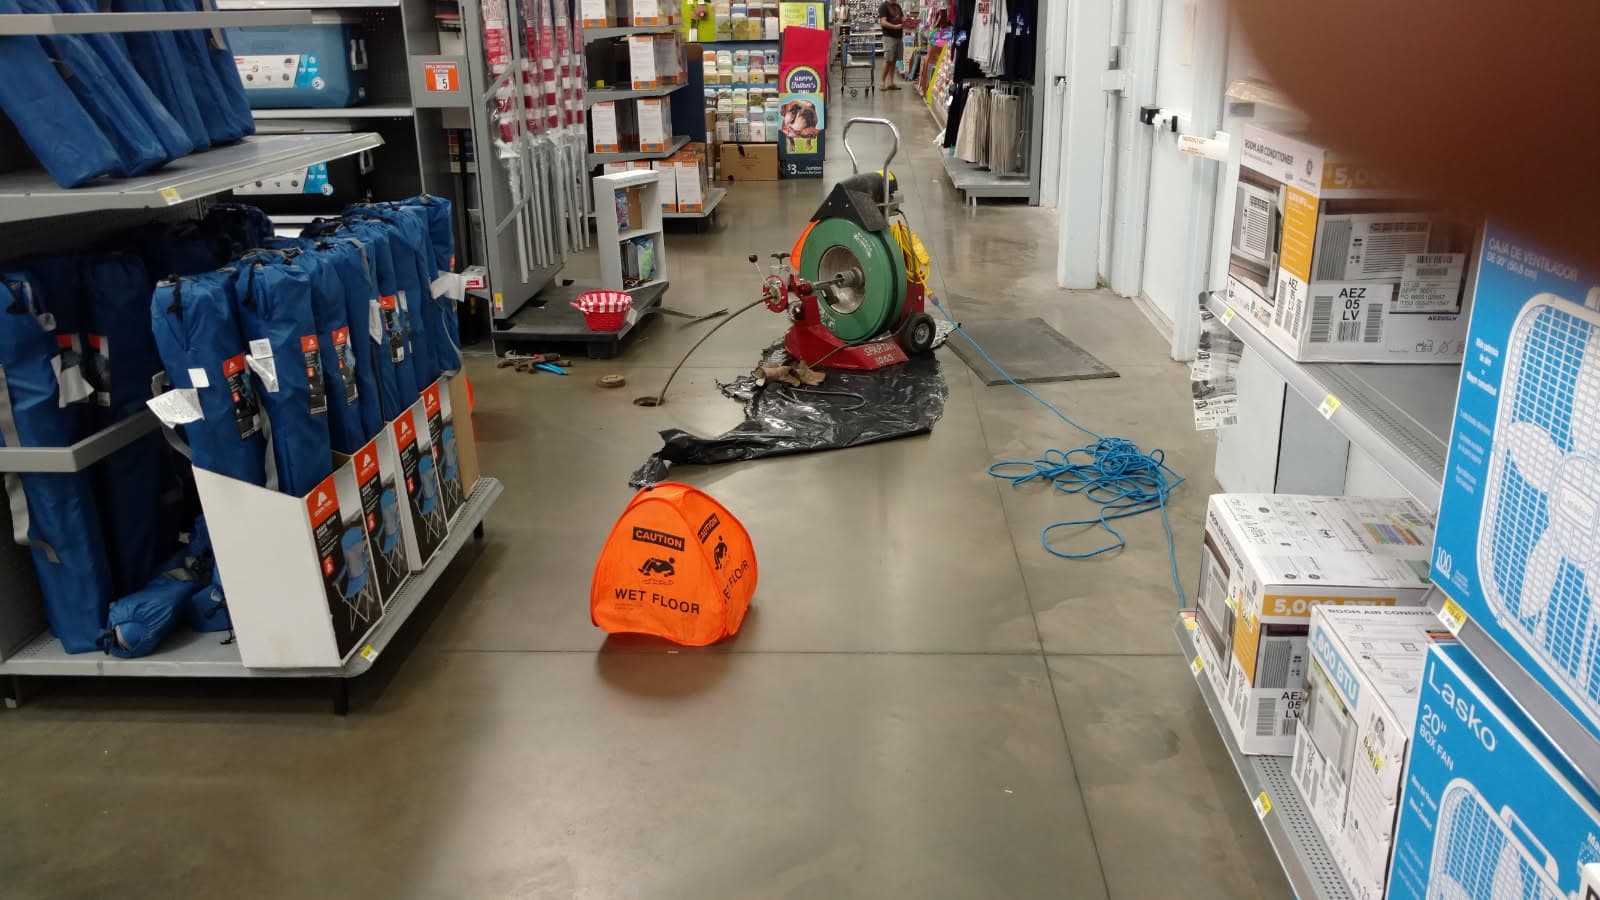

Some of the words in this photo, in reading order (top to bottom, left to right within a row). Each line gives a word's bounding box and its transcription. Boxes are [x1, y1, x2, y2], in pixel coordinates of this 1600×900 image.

[442, 78, 448, 89] 5
[1244, 138, 1257, 151] ROOM
[1257, 144, 1265, 155] AIR
[1264, 146, 1294, 166] CONDITIONER
[787, 163, 797, 175] $3
[1511, 246, 1523, 261] DE
[1523, 251, 1579, 282] VENTILADOR
[1338, 287, 1366, 299] AEZ
[1344, 299, 1360, 310] 05
[1342, 310, 1360, 321] LV
[635, 529, 683, 549] CAUTION
[728, 559, 750, 588] FLOOR
[615, 587, 647, 602] WET
[652, 593, 701, 615] FLOOR
[1336, 661, 1358, 701] BTU
[1287, 701, 1301, 710] 05
[1421, 703, 1447, 736] 20"
[1428, 661, 1496, 752] Lasko
[1419, 723, 1436, 751] BOX
[1436, 743, 1455, 772] FAN
